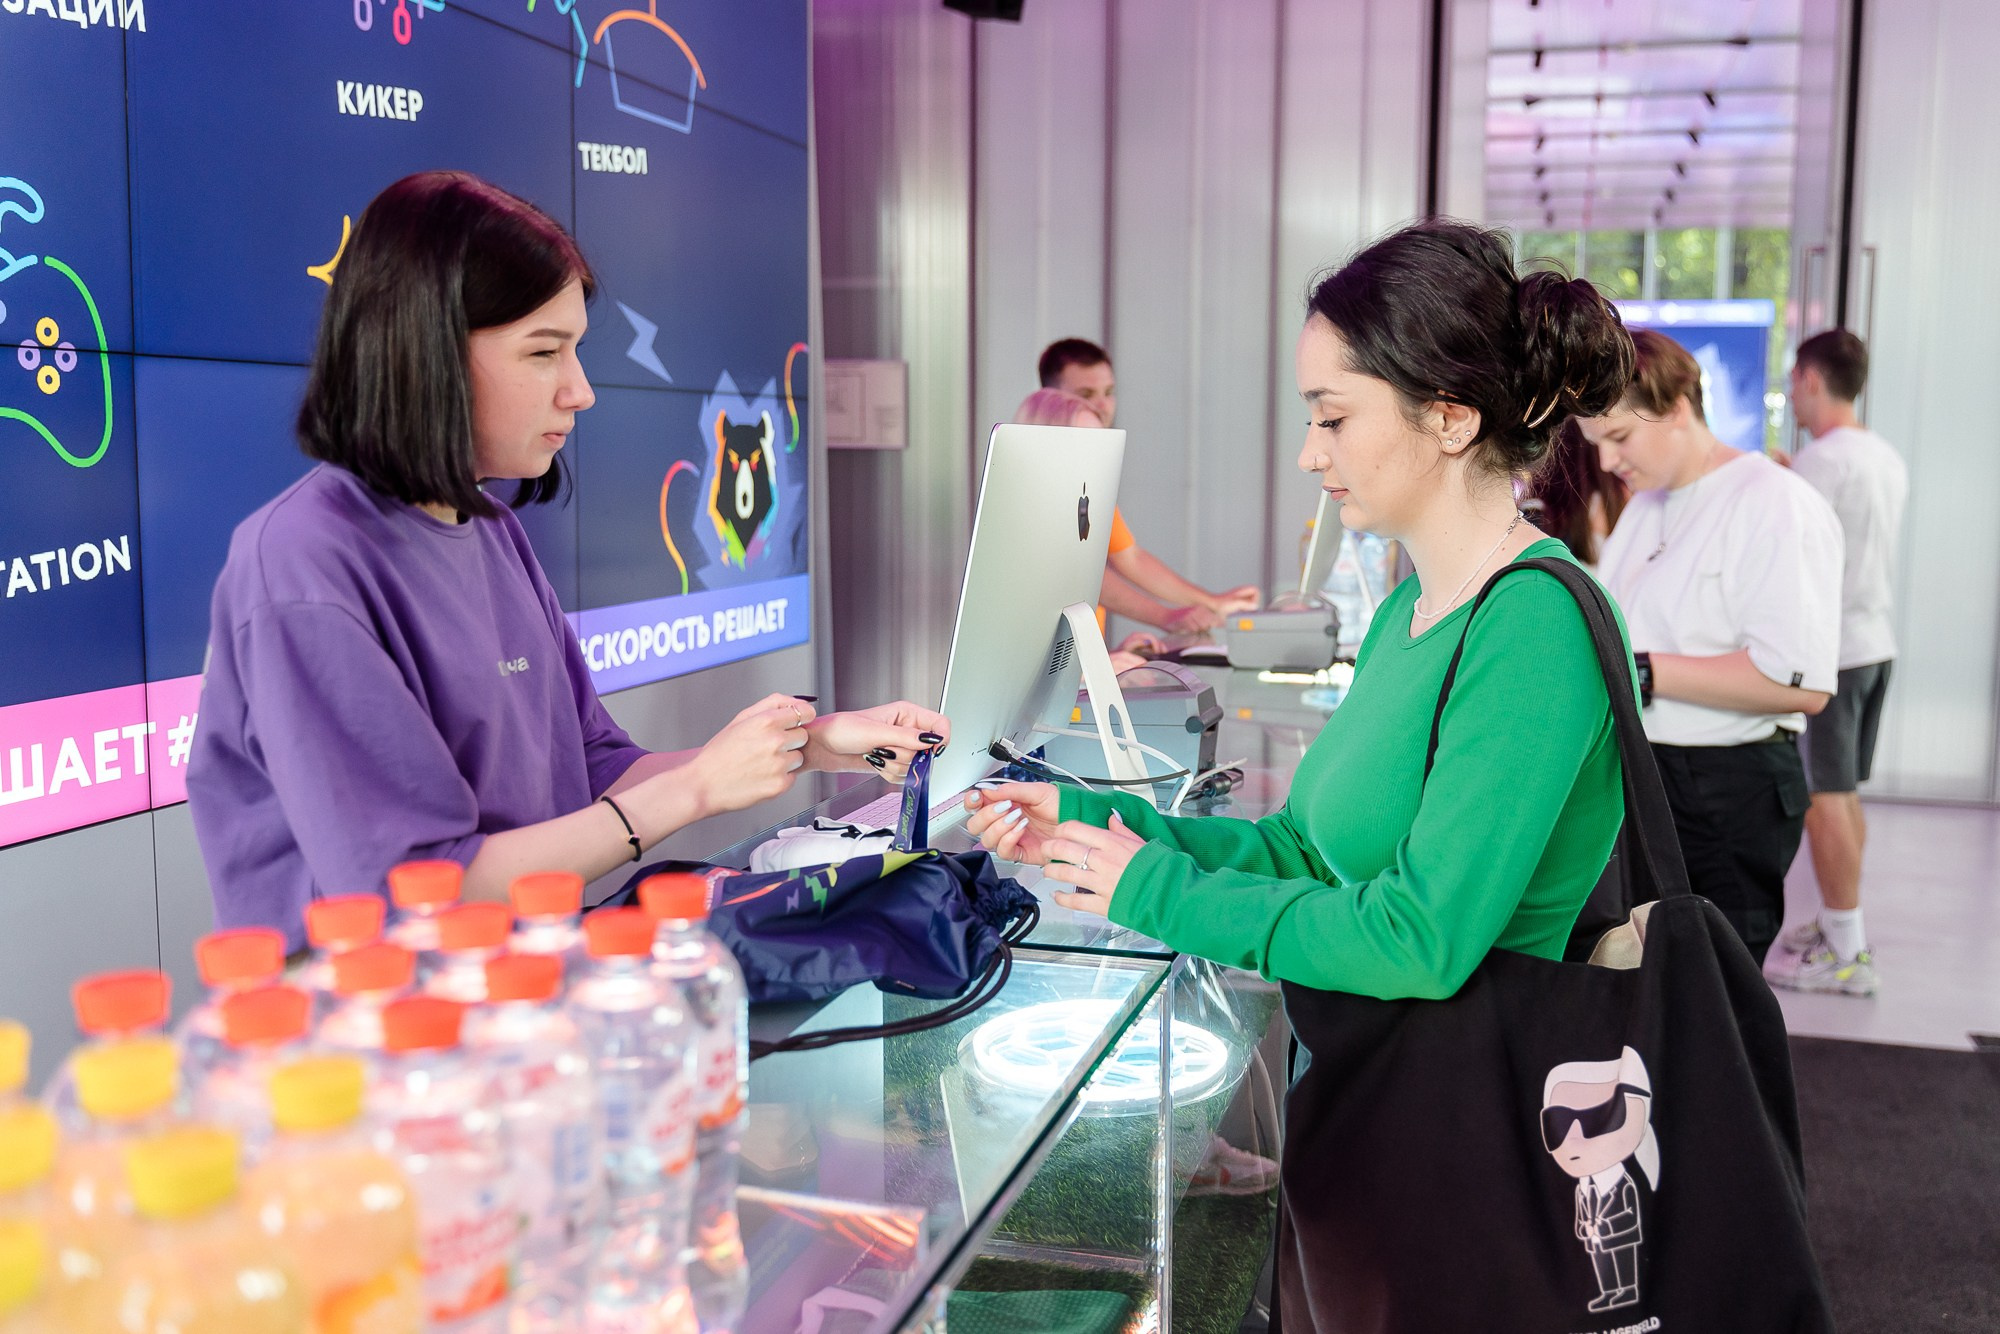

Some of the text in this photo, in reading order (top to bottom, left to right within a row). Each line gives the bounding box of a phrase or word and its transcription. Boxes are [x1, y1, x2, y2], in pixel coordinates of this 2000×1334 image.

[336, 79, 424, 122] КИКЕР
[577, 141, 648, 175] ТЕКБОЛ
[712, 597, 789, 645] РЕШАЕТ
[0, 721, 157, 806] ШАЕТ
